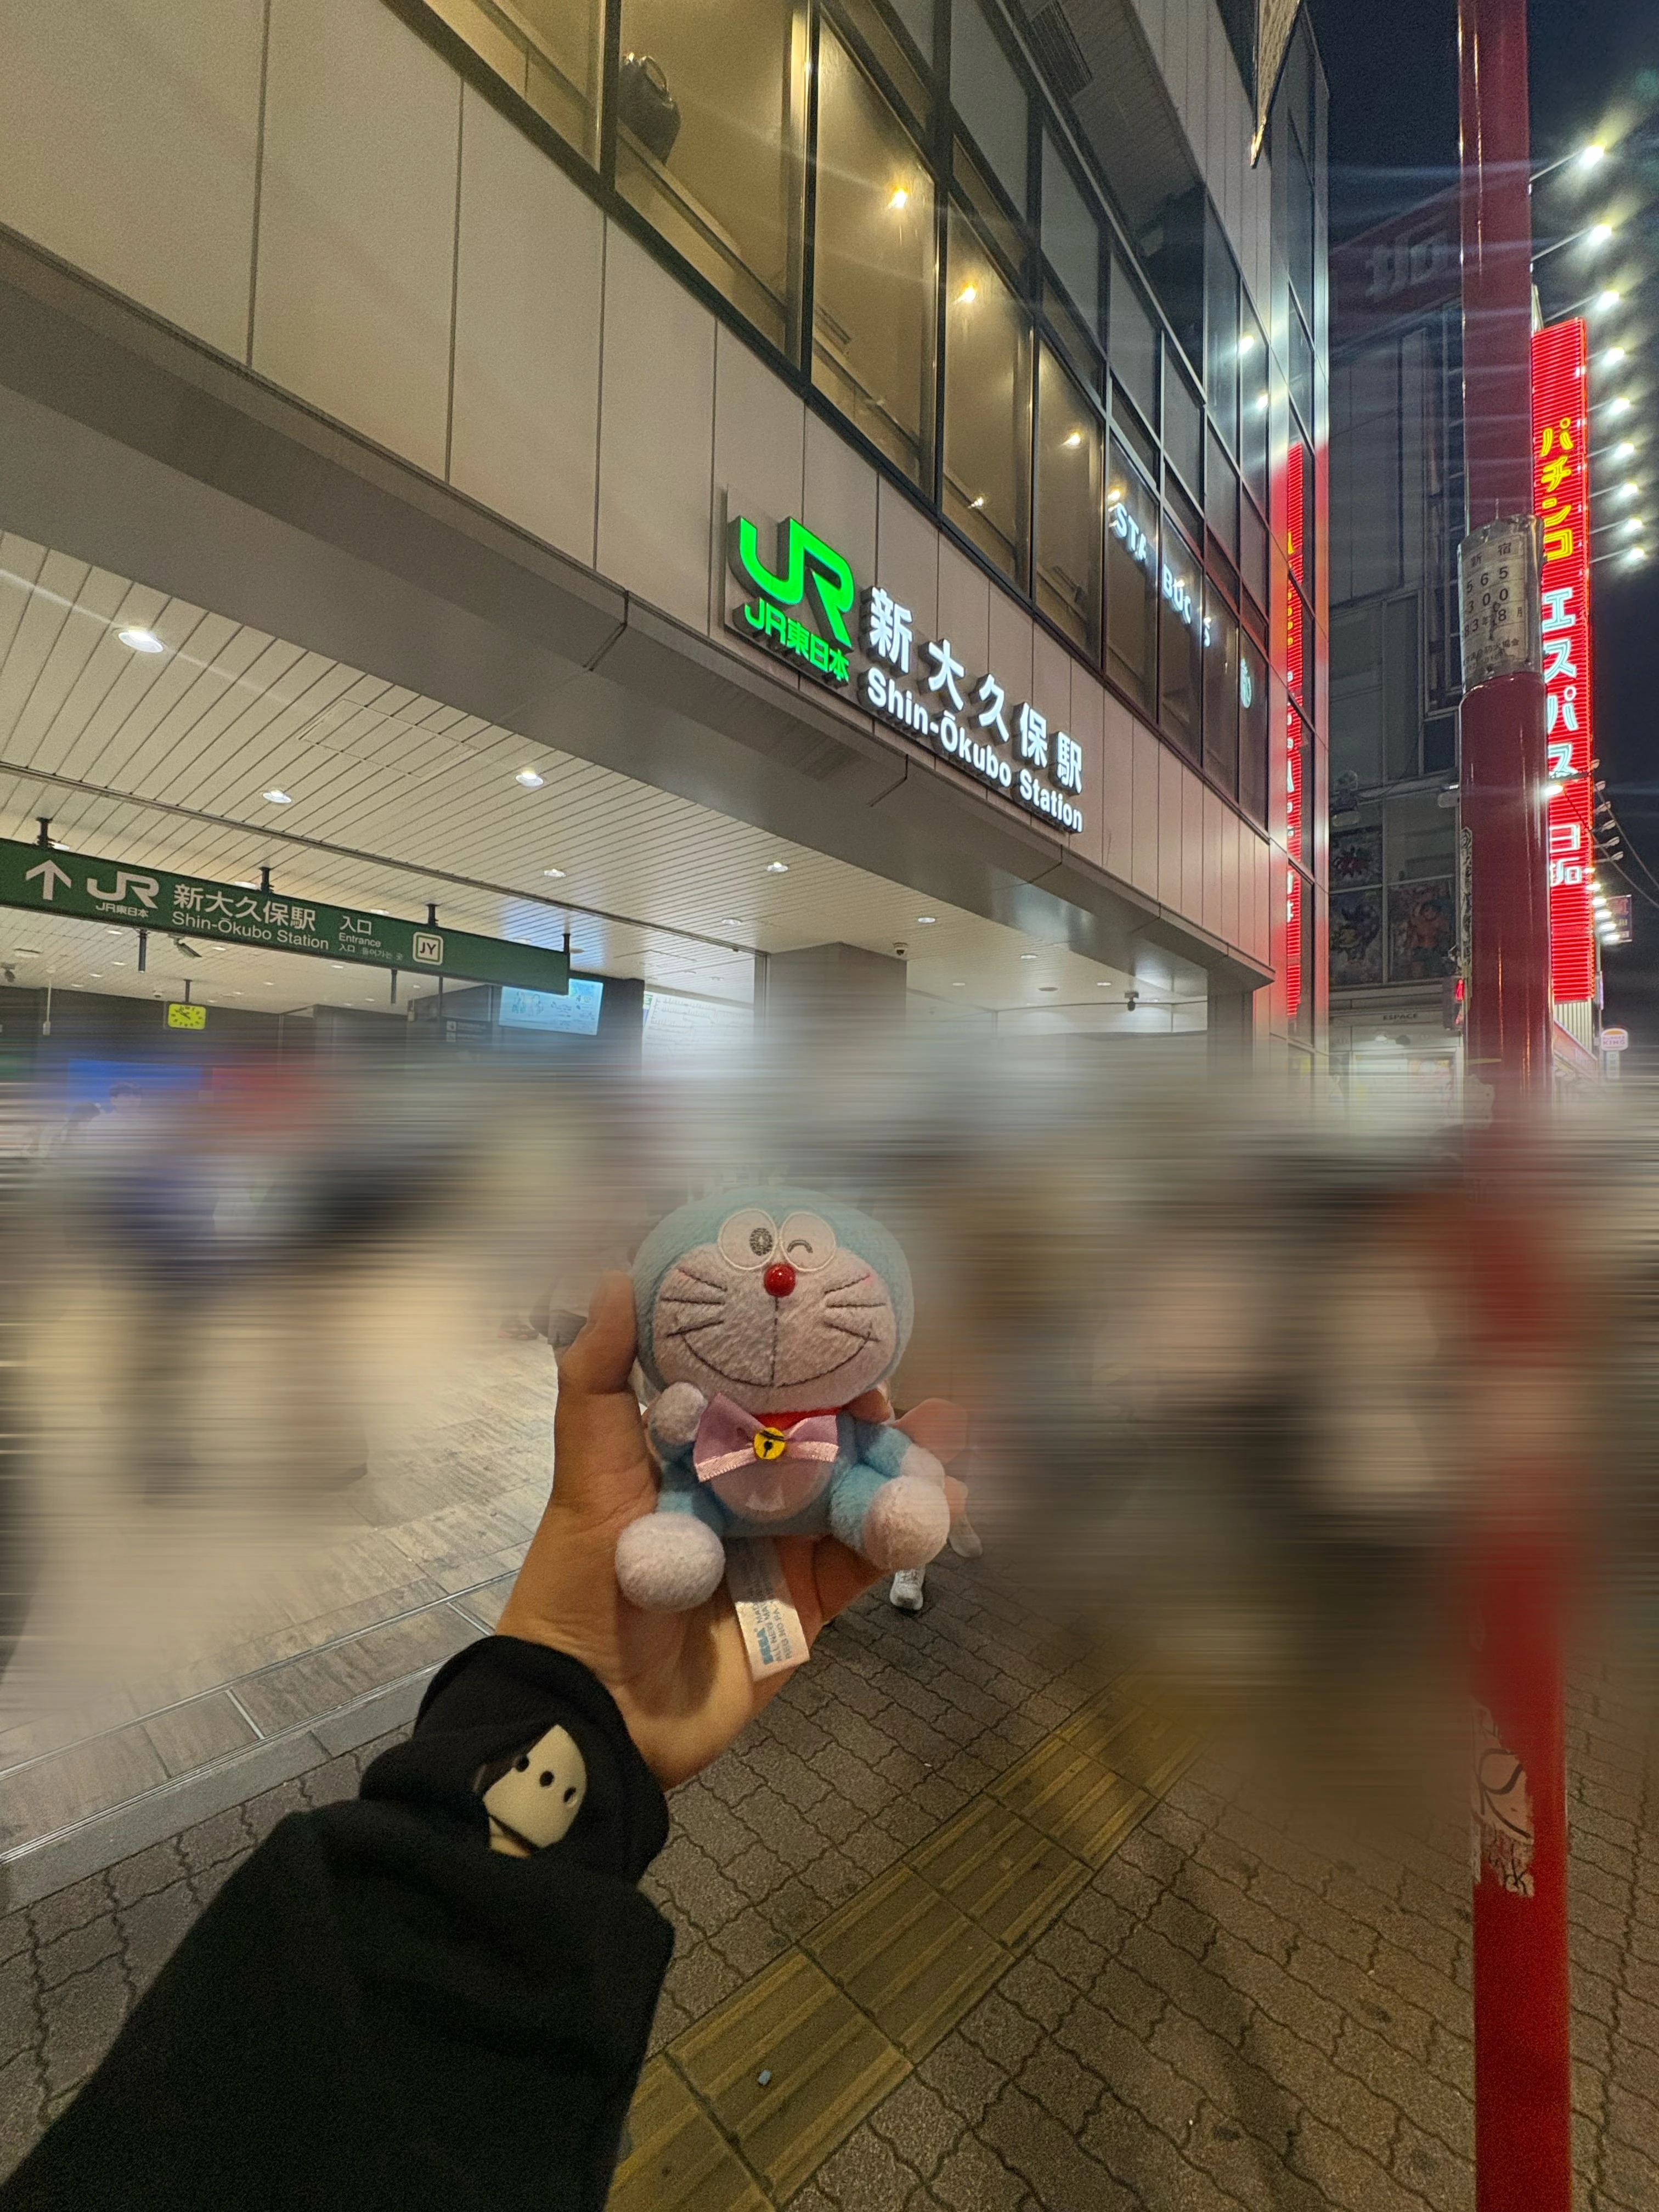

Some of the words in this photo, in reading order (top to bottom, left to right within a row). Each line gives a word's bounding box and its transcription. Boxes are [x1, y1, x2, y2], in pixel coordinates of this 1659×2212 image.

[1541, 417, 1573, 562] パチンコ
[740, 516, 854, 648] JR
[1466, 566, 1509, 593] 565
[1467, 588, 1509, 613] 300
[744, 596, 849, 682] JR東日本
[869, 586, 1083, 794] 新大久保駅
[1542, 588, 1578, 775] エスパス
[867, 667, 1012, 787] Shin-Ōkubo
[1019, 769, 1083, 833] Station
[87, 871, 159, 909] JR
[173, 884, 316, 932] 新大久保駅
[95, 902, 150, 918] JR東日本
[340, 915, 372, 935] 入口
[172, 911, 272, 940] Shin-Ōkubo
[276, 929, 329, 950] Station
[338, 932, 382, 948] Entrance
[338, 943, 356, 953] 入口
[419, 942, 437, 955] JY
